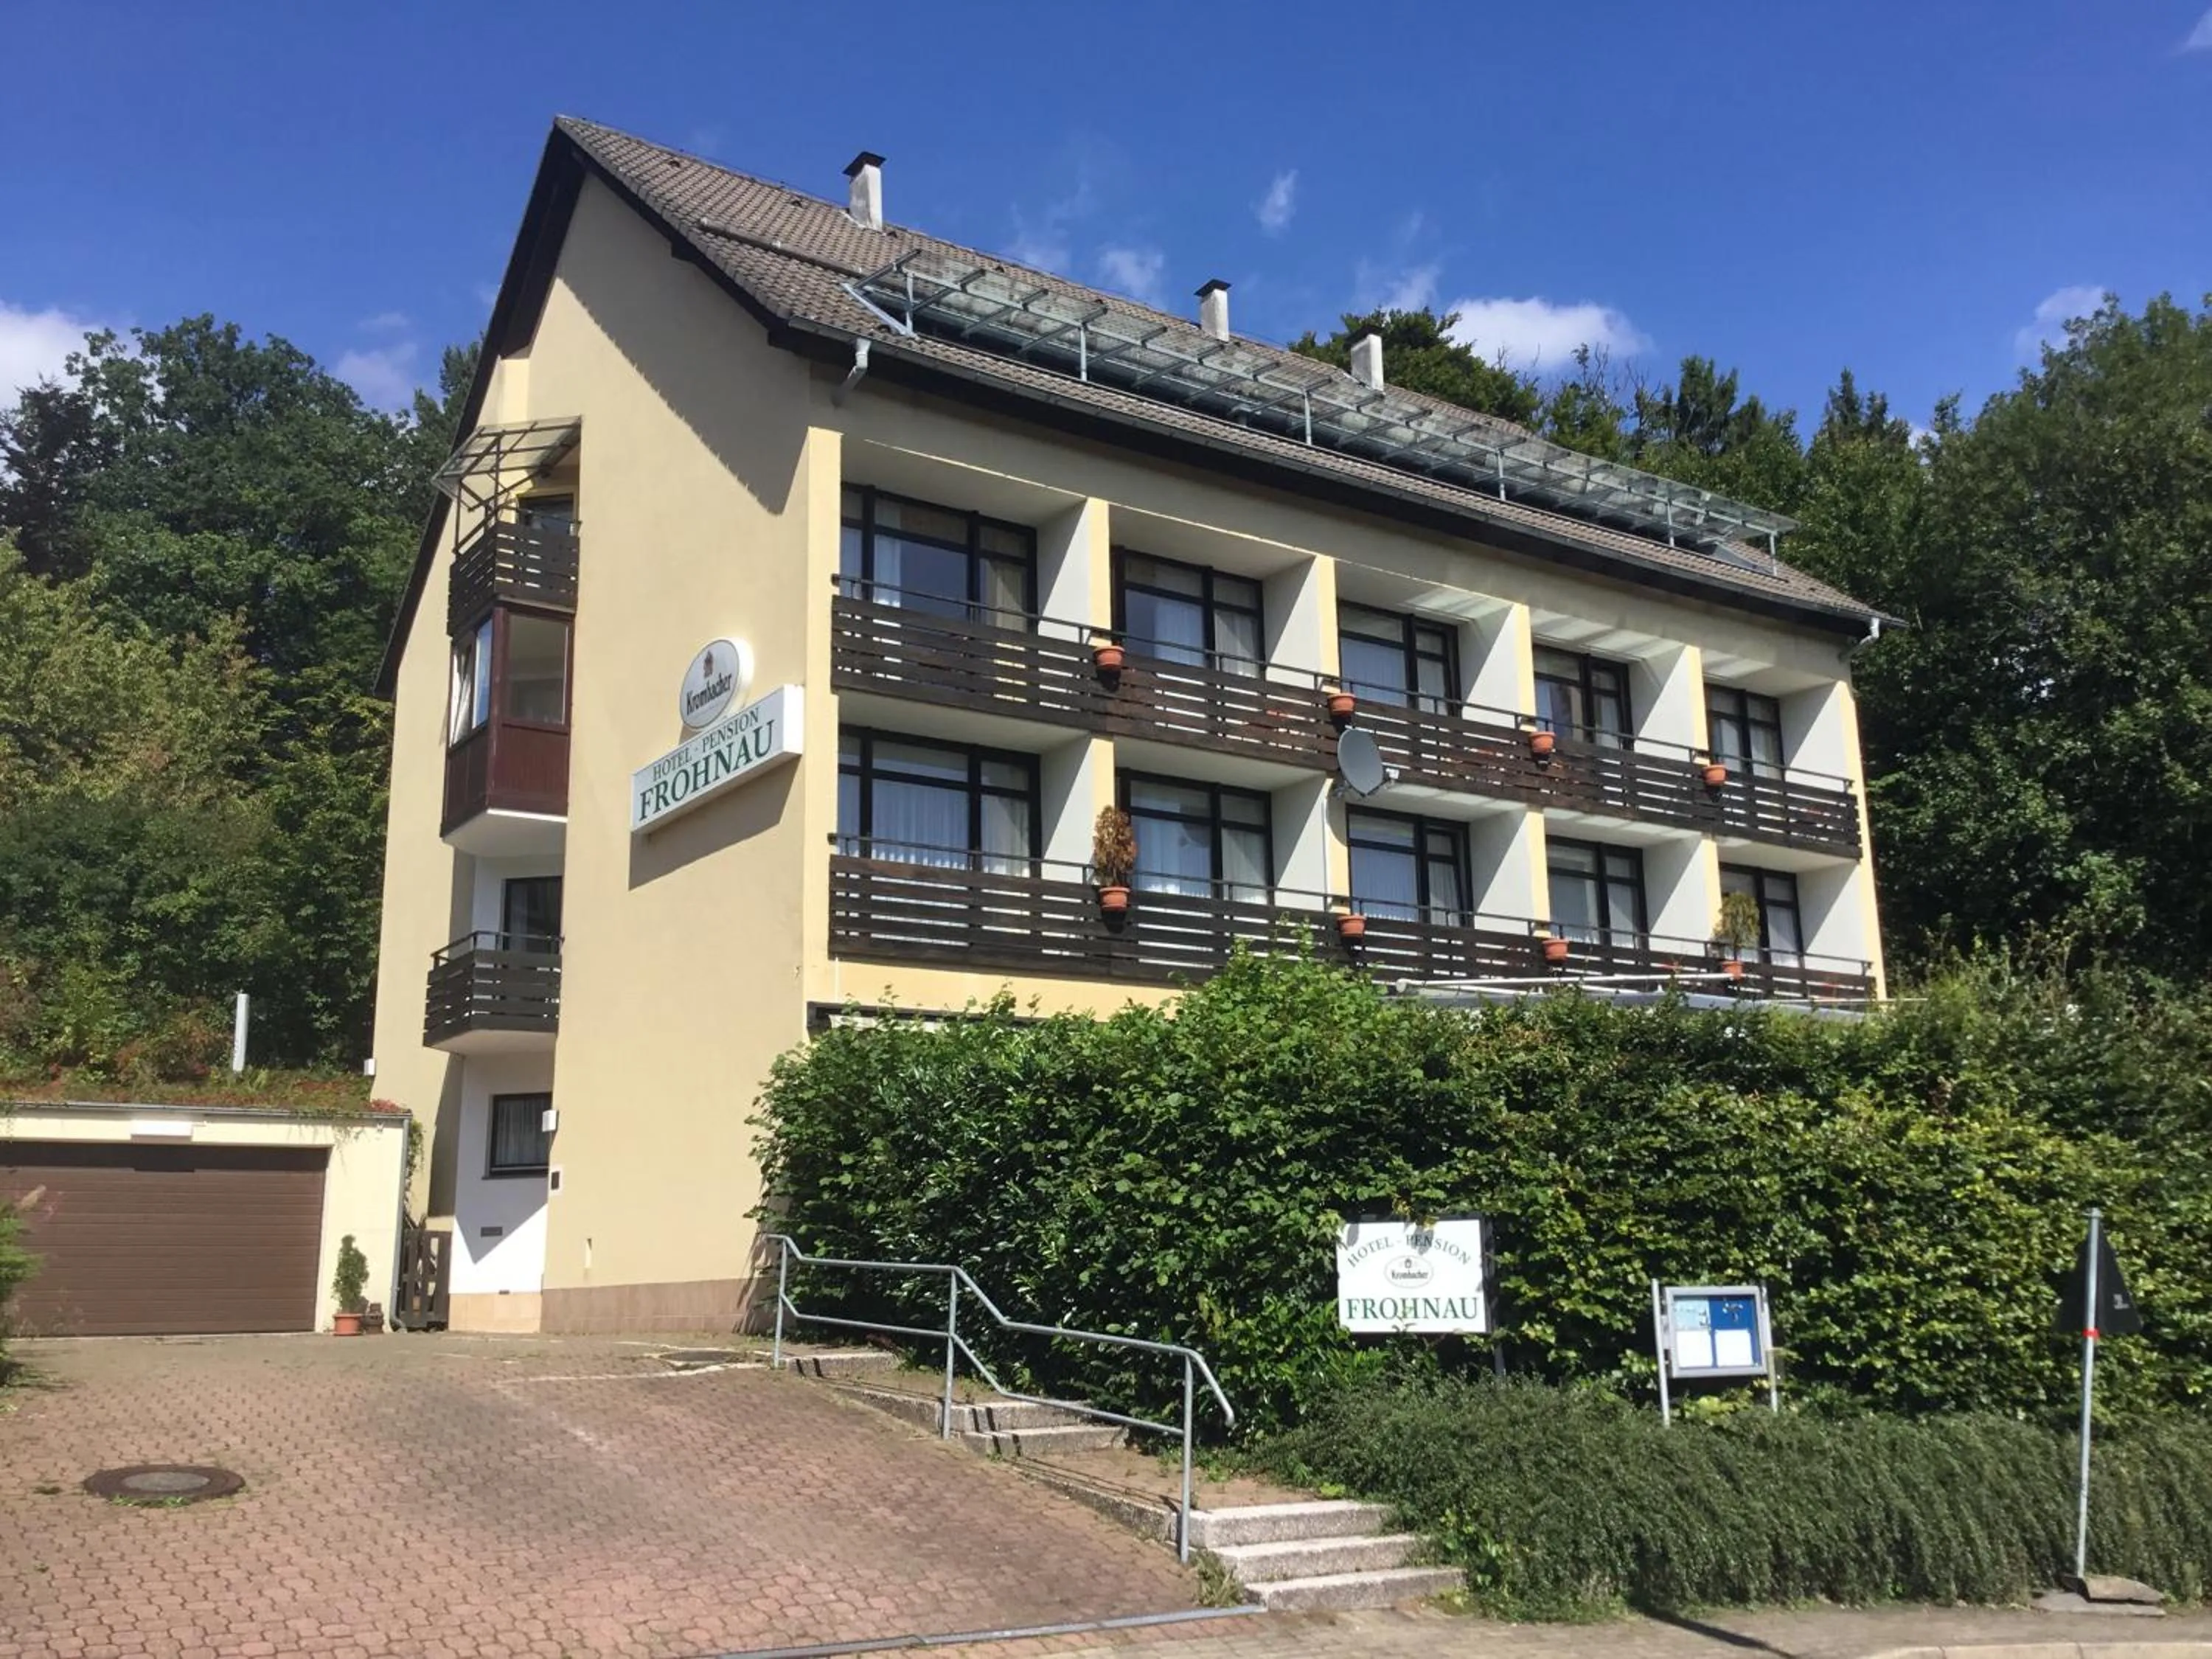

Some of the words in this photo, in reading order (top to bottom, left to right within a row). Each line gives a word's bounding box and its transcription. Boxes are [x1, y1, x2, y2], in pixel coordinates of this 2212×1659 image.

[686, 672, 732, 716] Krombacher
[653, 748, 692, 782] HOTEL
[702, 707, 759, 752] PENSION
[639, 719, 775, 822] FROHNAU
[1347, 1237, 1394, 1267] HOTEL
[1405, 1234, 1471, 1265] PENSION
[1391, 1270, 1429, 1280] Krombacher
[1346, 1297, 1478, 1321] FROHNAU
